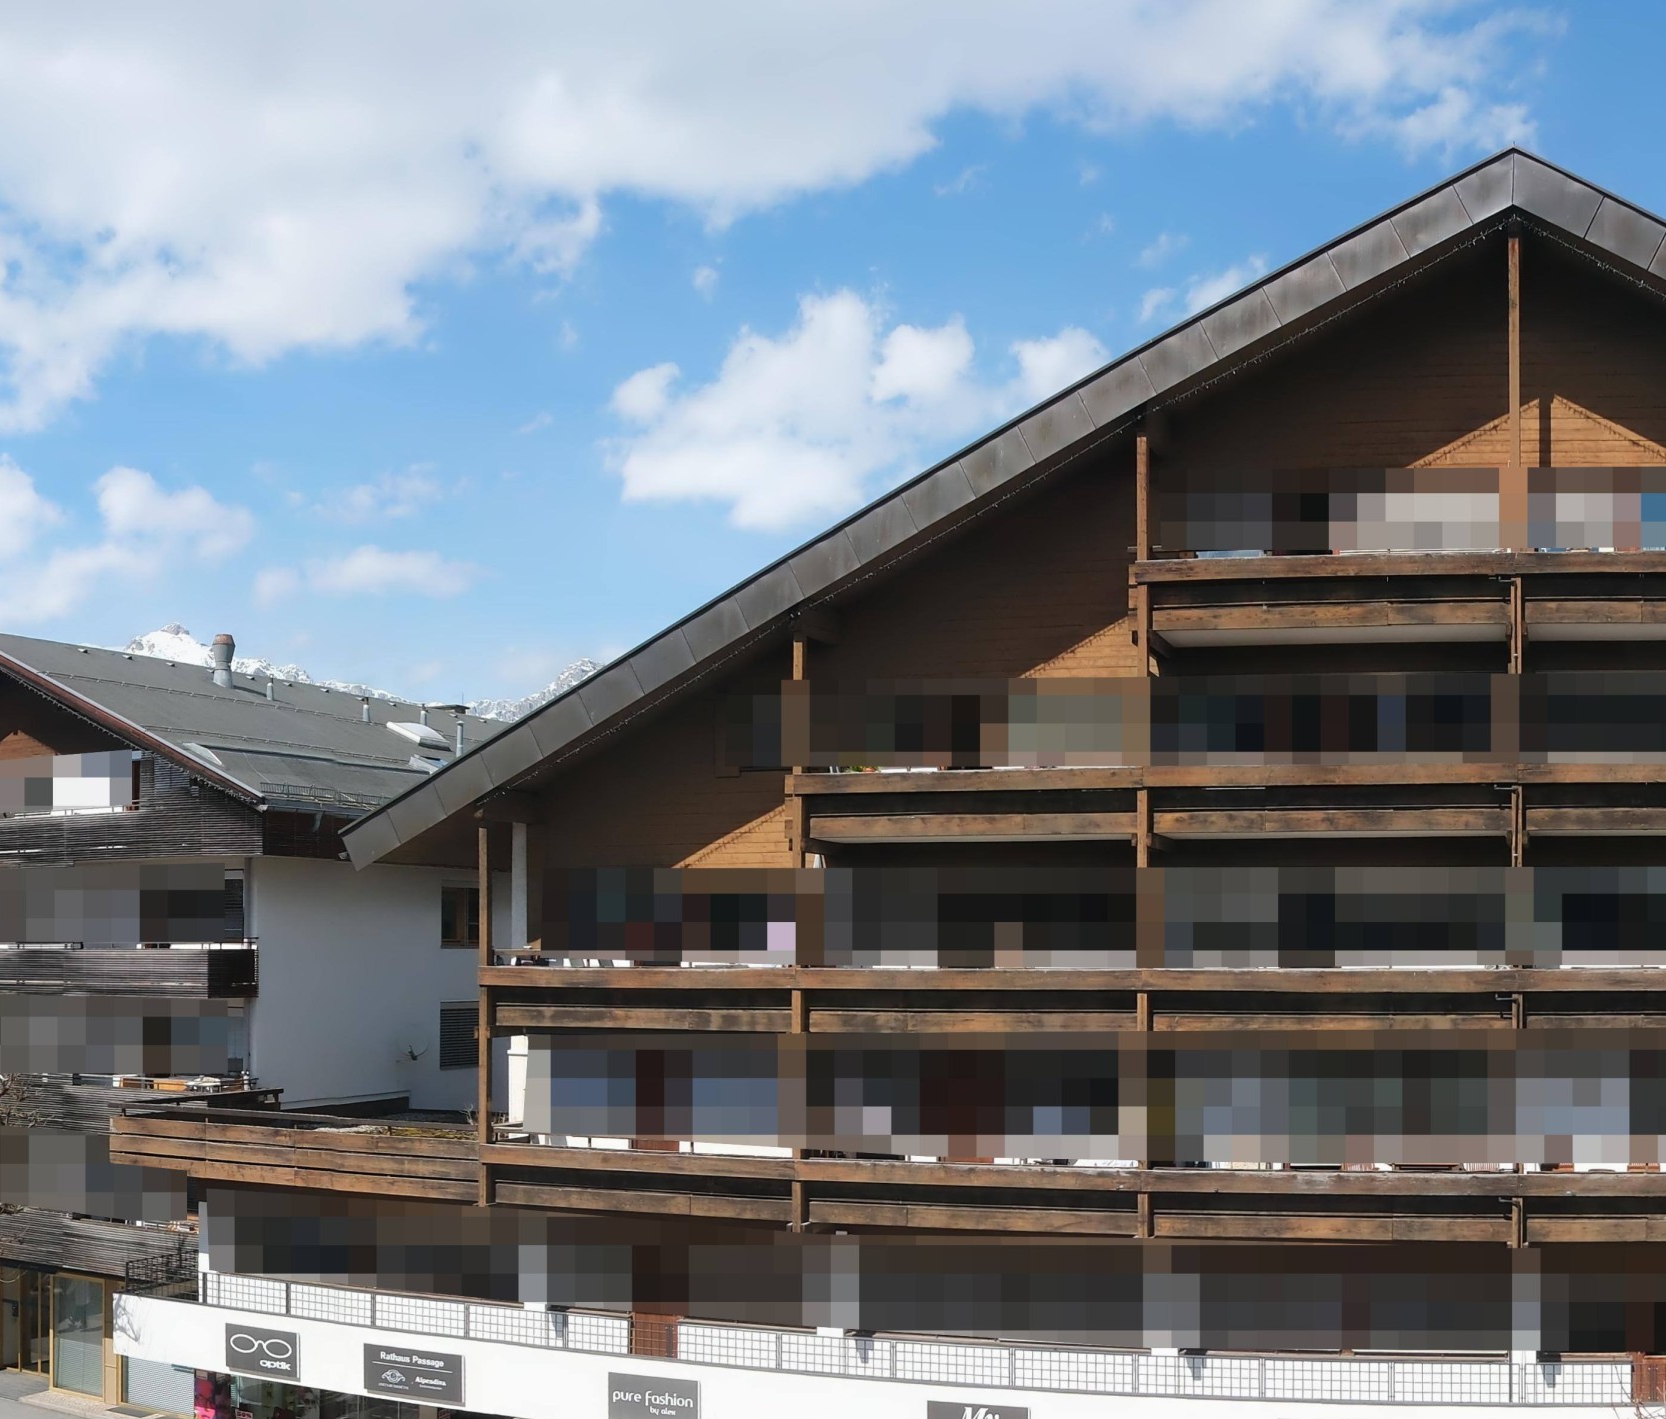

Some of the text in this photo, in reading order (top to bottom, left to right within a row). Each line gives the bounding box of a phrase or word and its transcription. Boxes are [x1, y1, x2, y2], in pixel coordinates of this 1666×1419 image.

[259, 1358, 291, 1371] optik
[380, 1351, 445, 1368] Rathaus Passage
[612, 1390, 694, 1408] pure fashion
[649, 1406, 660, 1416] by
